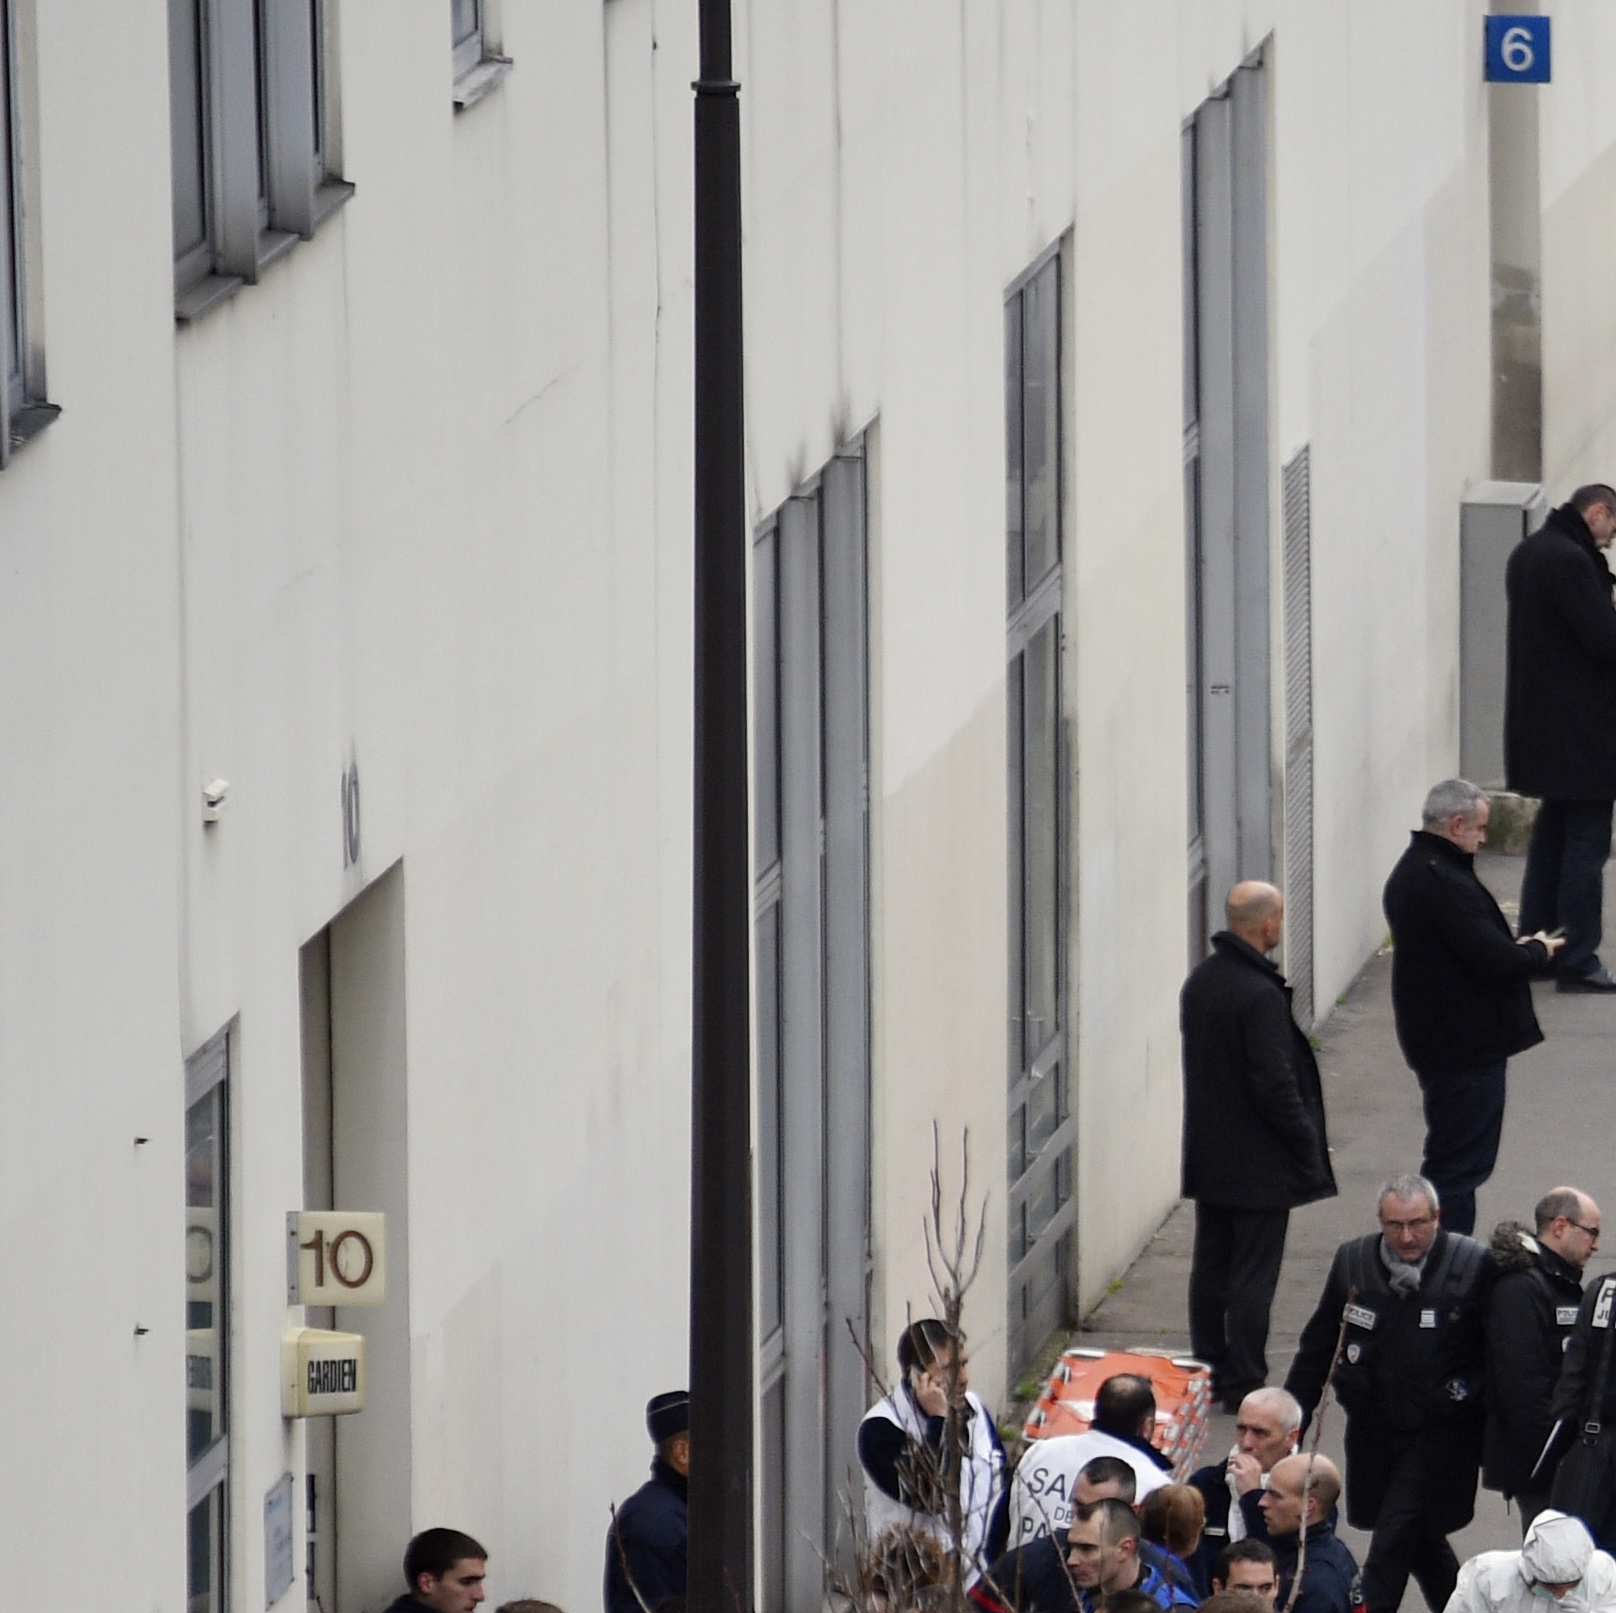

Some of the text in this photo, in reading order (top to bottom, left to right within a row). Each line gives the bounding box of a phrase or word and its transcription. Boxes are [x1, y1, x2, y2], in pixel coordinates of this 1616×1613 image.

[1501, 27, 1534, 71] 6
[301, 1229, 375, 1289] 10
[307, 1358, 358, 1395] GARDIEN
[1029, 1468, 1074, 1504] SA
[1053, 1507, 1074, 1525] DE
